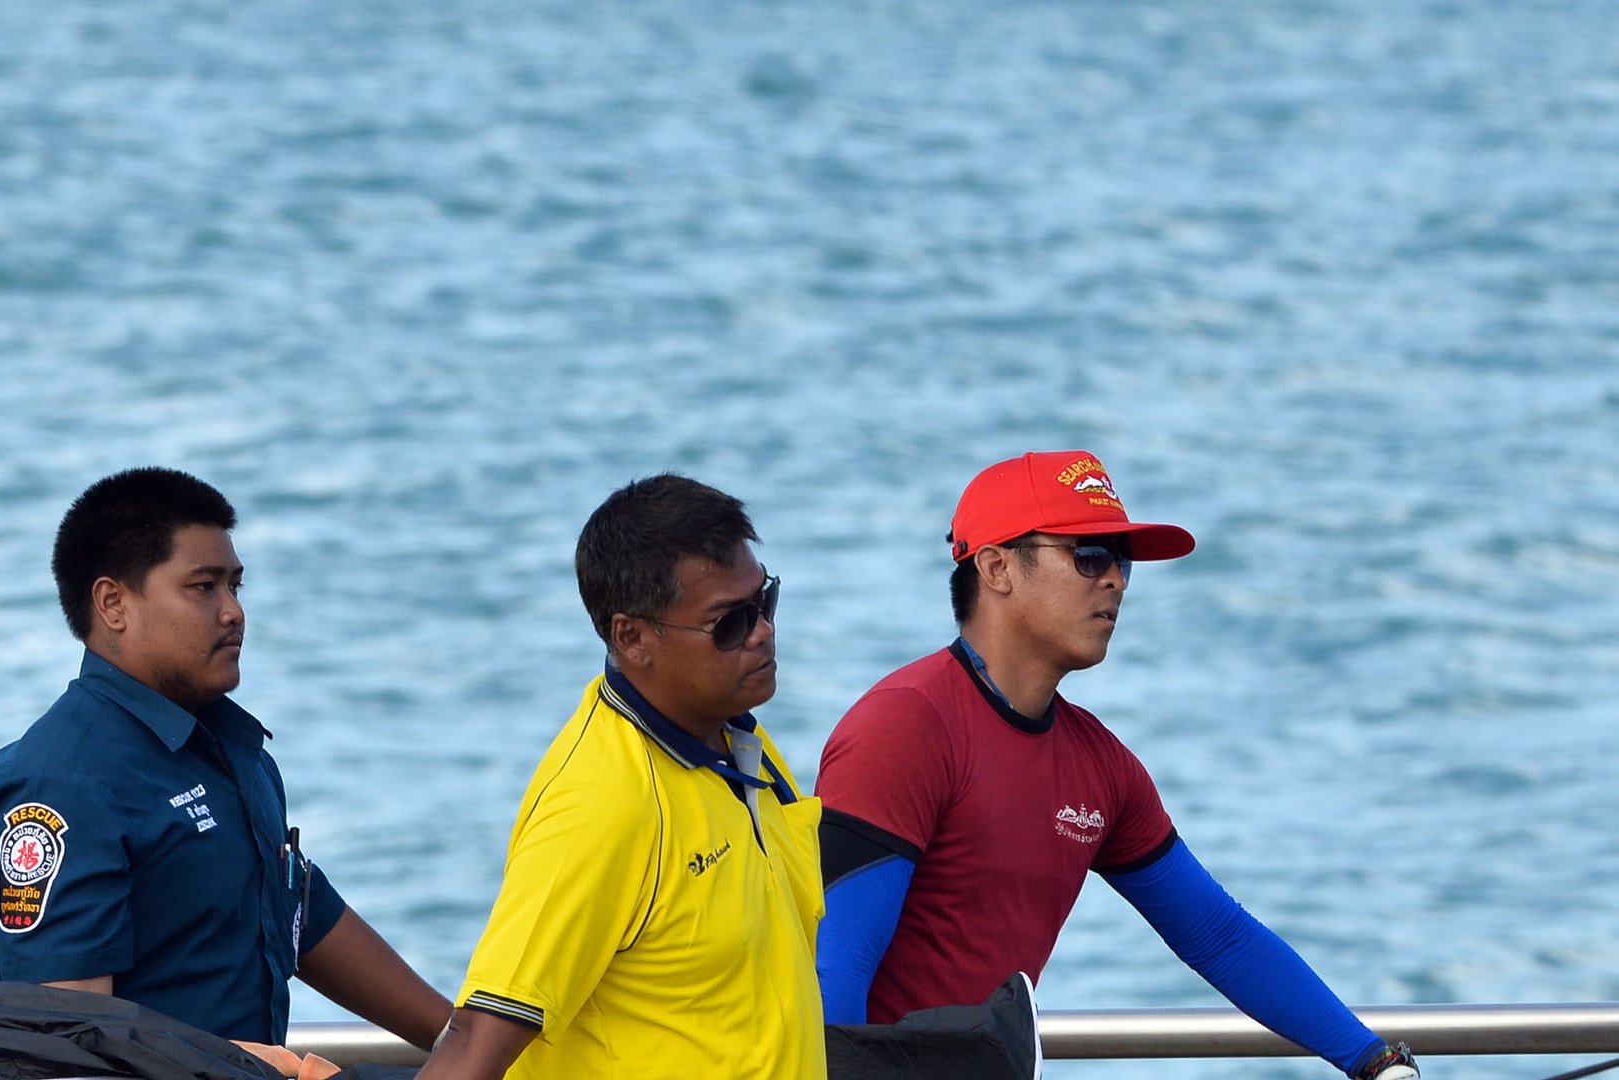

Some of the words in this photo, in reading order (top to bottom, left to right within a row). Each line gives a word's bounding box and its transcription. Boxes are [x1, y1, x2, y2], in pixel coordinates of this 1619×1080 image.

[1057, 458, 1096, 486] SEARCH
[10, 806, 63, 832] RESCUE
[26, 853, 55, 881] RESCUE
